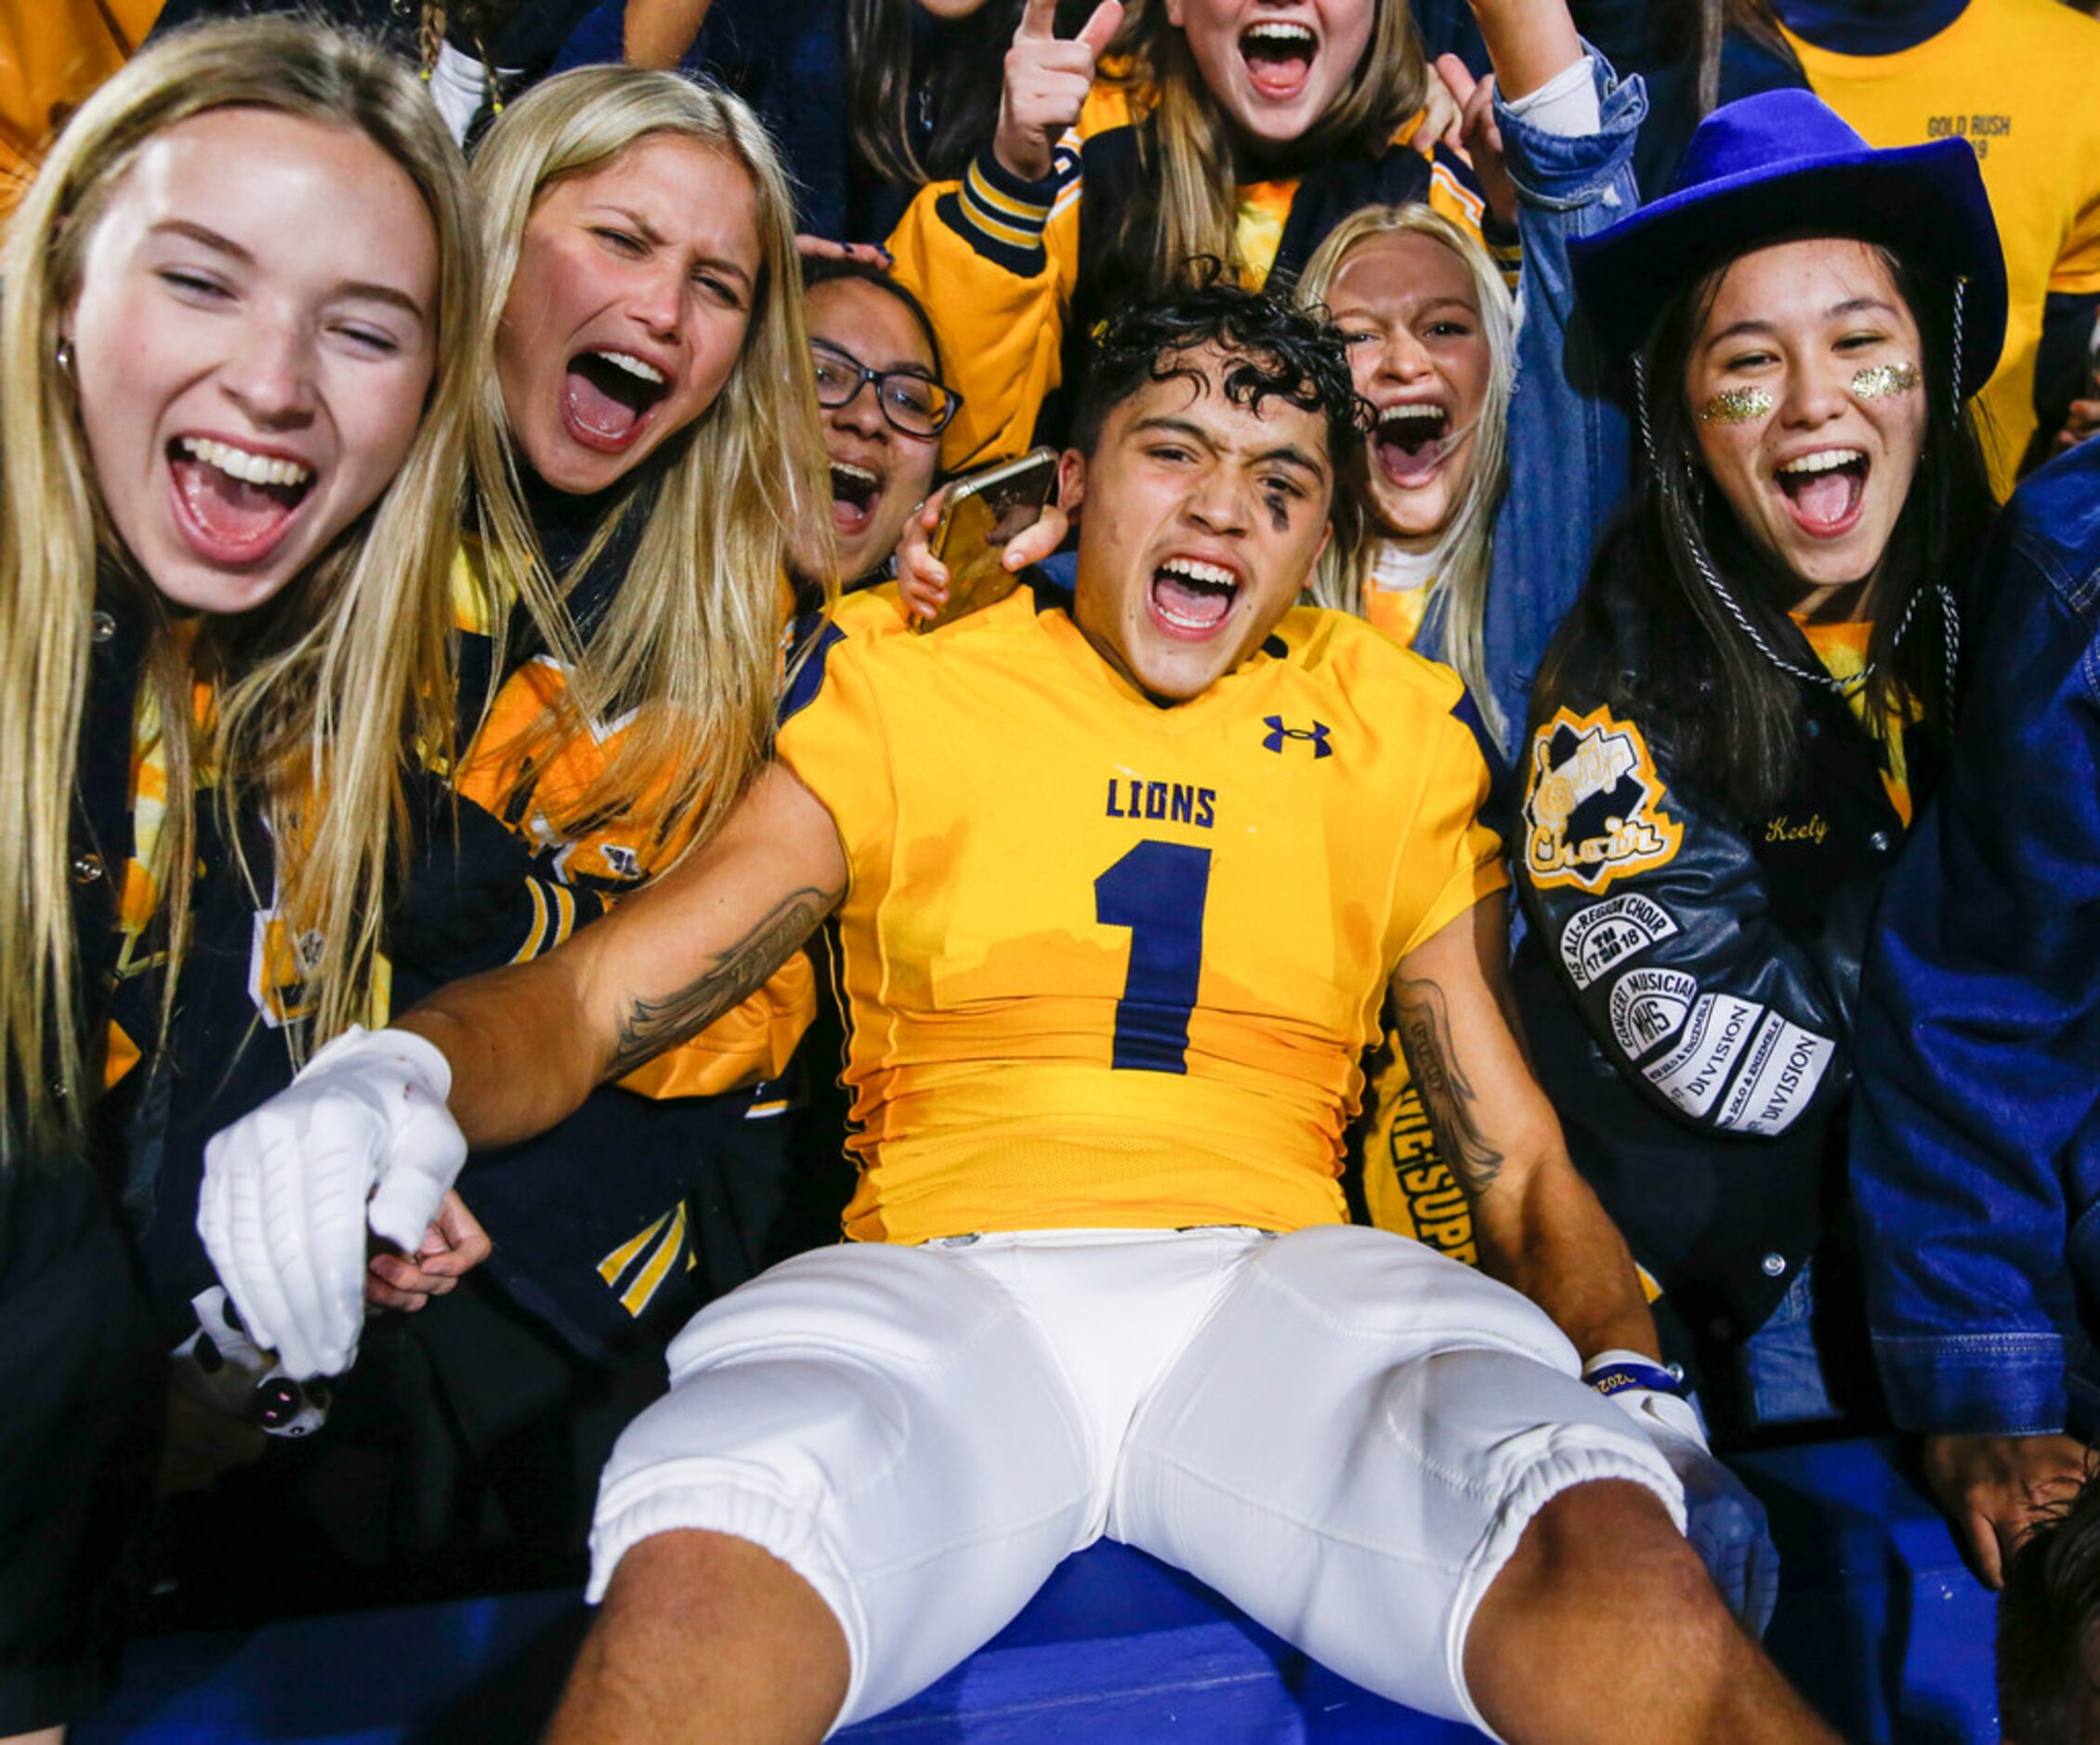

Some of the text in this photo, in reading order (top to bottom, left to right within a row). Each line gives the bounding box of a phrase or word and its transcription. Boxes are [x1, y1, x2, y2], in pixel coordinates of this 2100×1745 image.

[1927, 114, 2011, 138] GOLD RUSH
[1107, 779, 1216, 829] LIONS
[1765, 814, 1829, 846] Keely
[1620, 928, 1640, 949] 18
[1625, 898, 1668, 935] CHOIR
[1094, 838, 1213, 1075] 1
[1613, 985, 1634, 1049] CONCERT
[1687, 1004, 1749, 1097] DIVISION
[1748, 1019, 1781, 1078] ENSEMBLE
[1761, 1033, 1818, 1122] DIVISION
